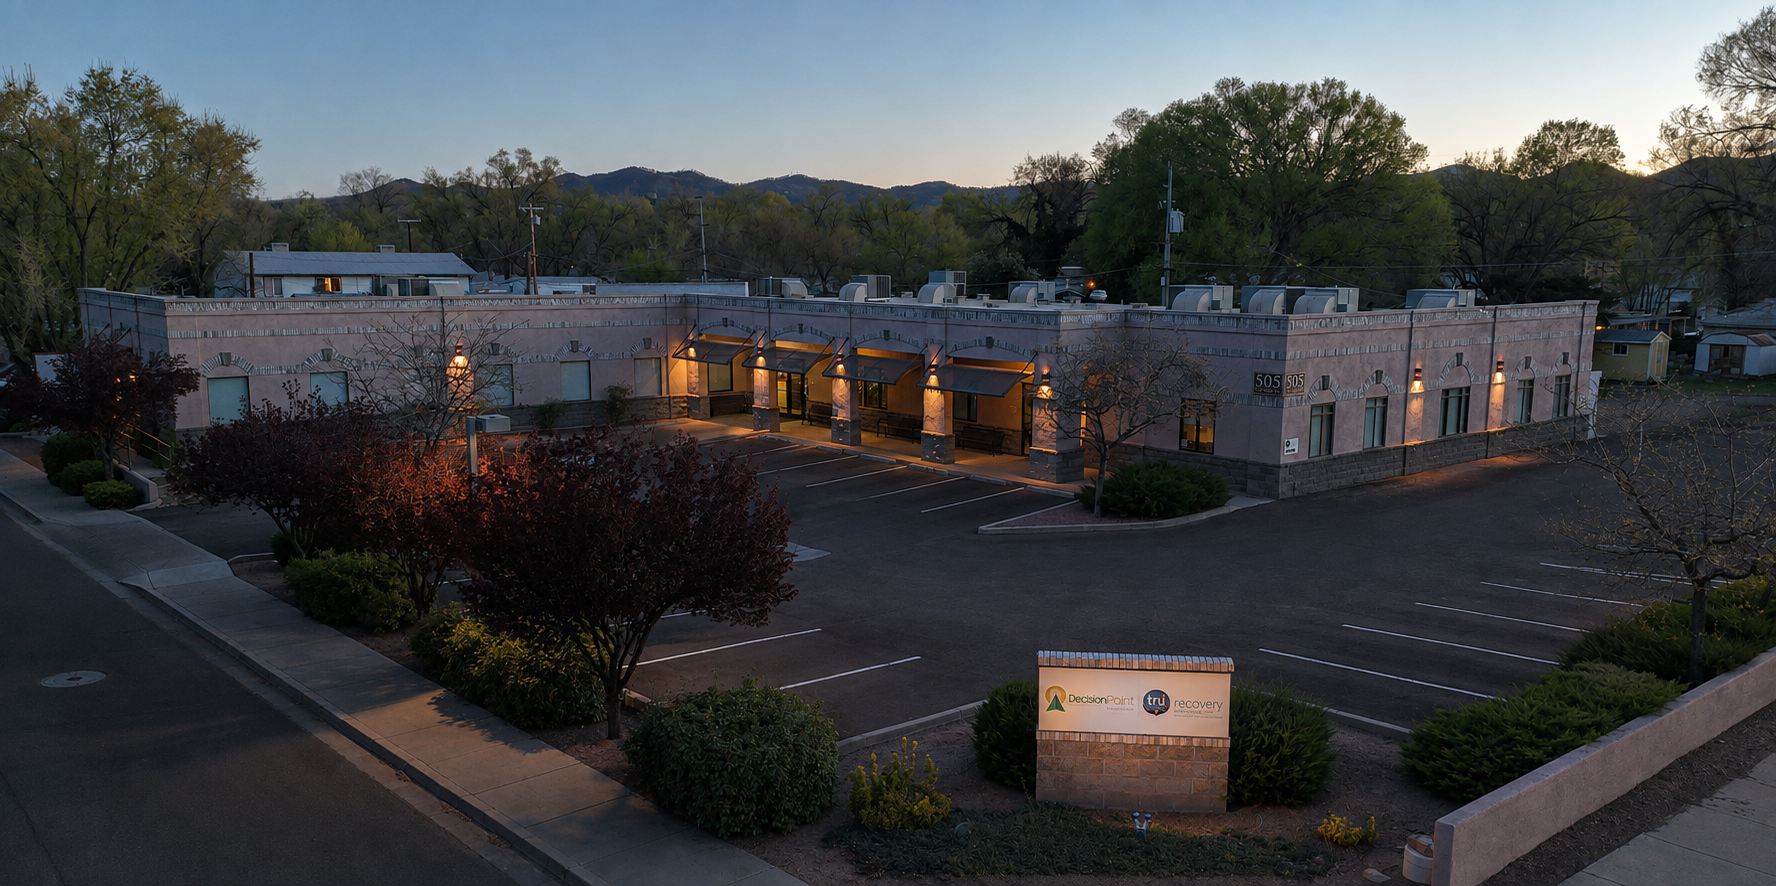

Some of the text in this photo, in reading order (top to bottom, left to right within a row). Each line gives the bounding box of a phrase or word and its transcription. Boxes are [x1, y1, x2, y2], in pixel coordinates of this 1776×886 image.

[1255, 374, 1281, 388] 505
[1286, 374, 1304, 389] 505
[1174, 700, 1223, 712] recovery
